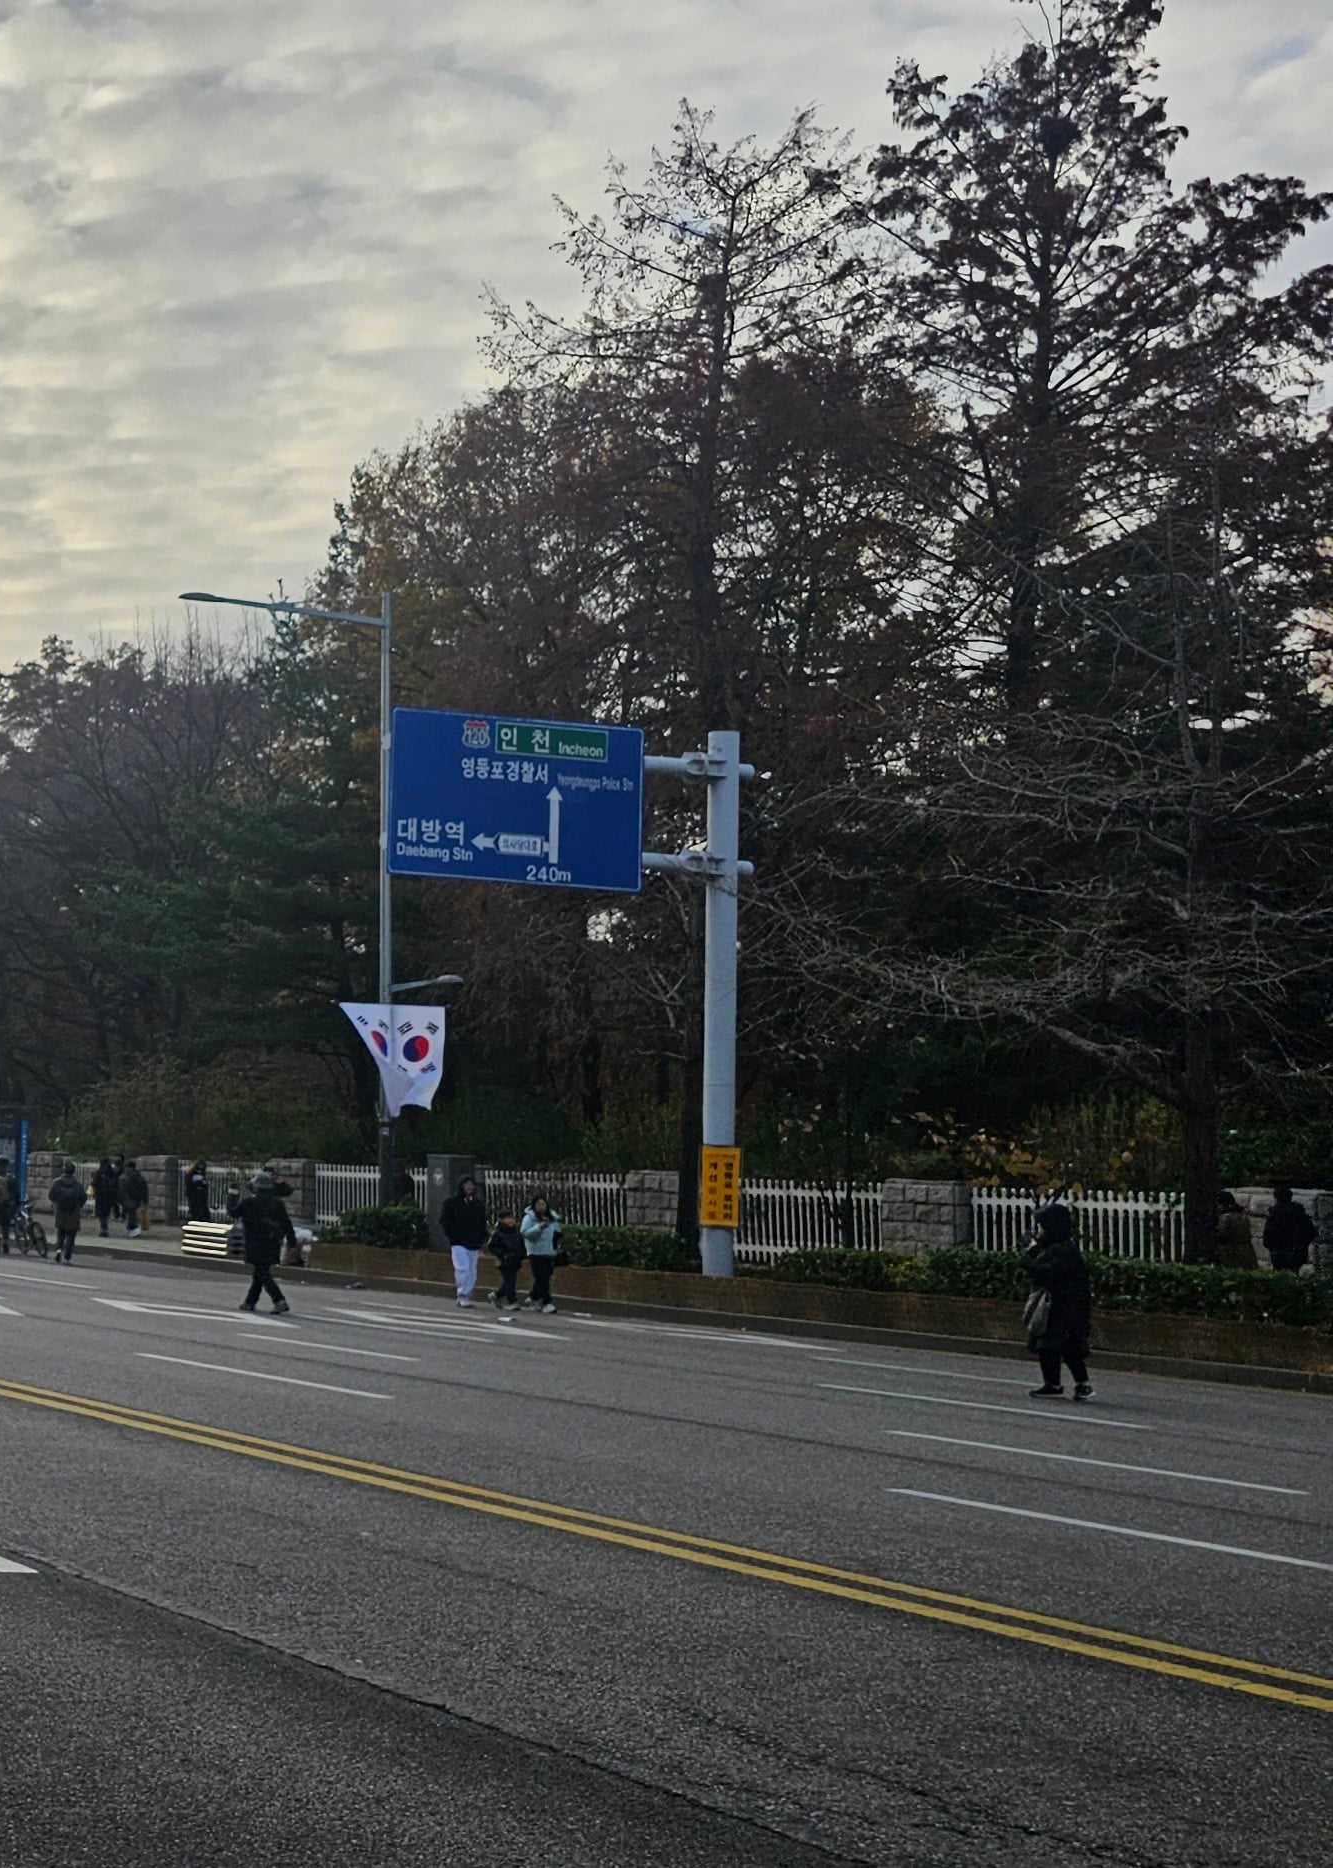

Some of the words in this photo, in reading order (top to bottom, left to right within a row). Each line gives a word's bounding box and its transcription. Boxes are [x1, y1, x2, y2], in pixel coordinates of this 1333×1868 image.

[466, 729, 486, 745] 120
[558, 742, 604, 759] Incheon
[461, 756, 549, 785] 영등포경찰서
[396, 817, 465, 846] 대방역
[396, 843, 450, 863] Daebang
[452, 847, 474, 862] Stn
[526, 865, 572, 883] 240m
